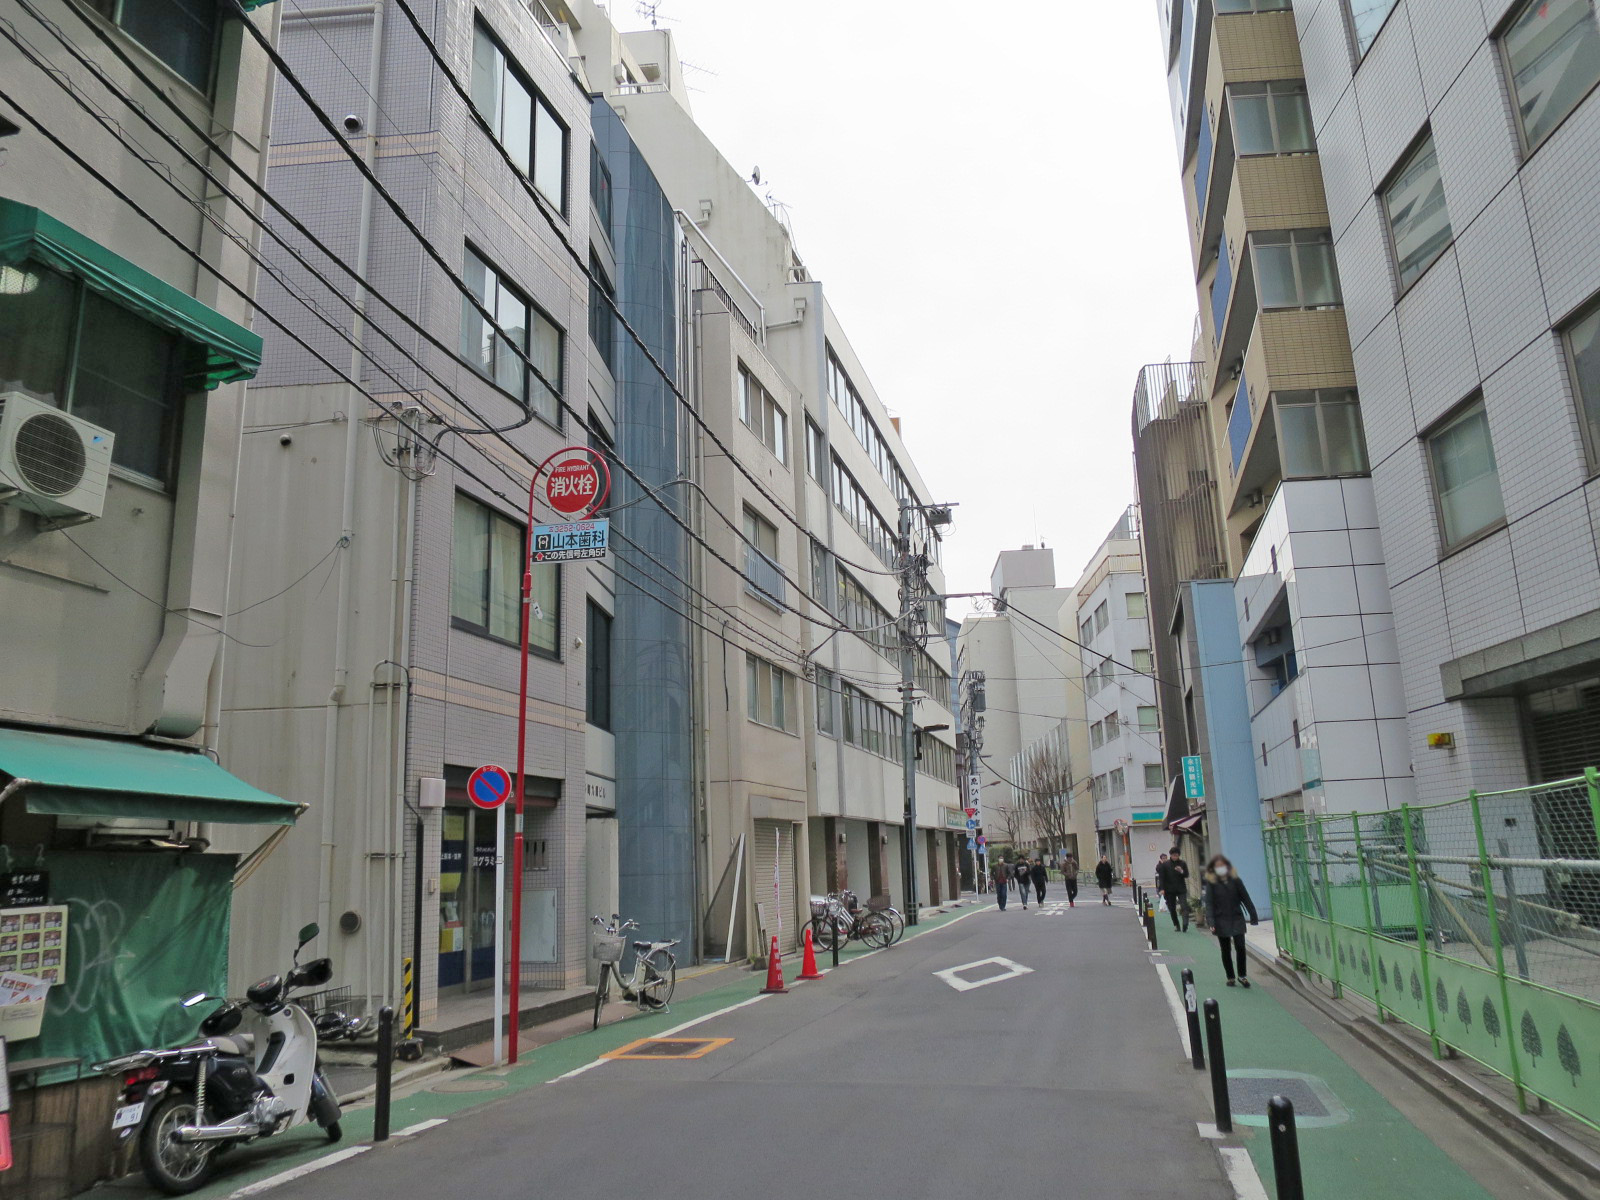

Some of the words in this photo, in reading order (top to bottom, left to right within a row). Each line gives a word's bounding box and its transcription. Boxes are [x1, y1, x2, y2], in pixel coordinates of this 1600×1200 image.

[567, 464, 590, 472] HYDRANT
[551, 474, 594, 497] 消火栓
[552, 530, 605, 549] 山本歯科
[544, 548, 606, 560] この先信号左角5F
